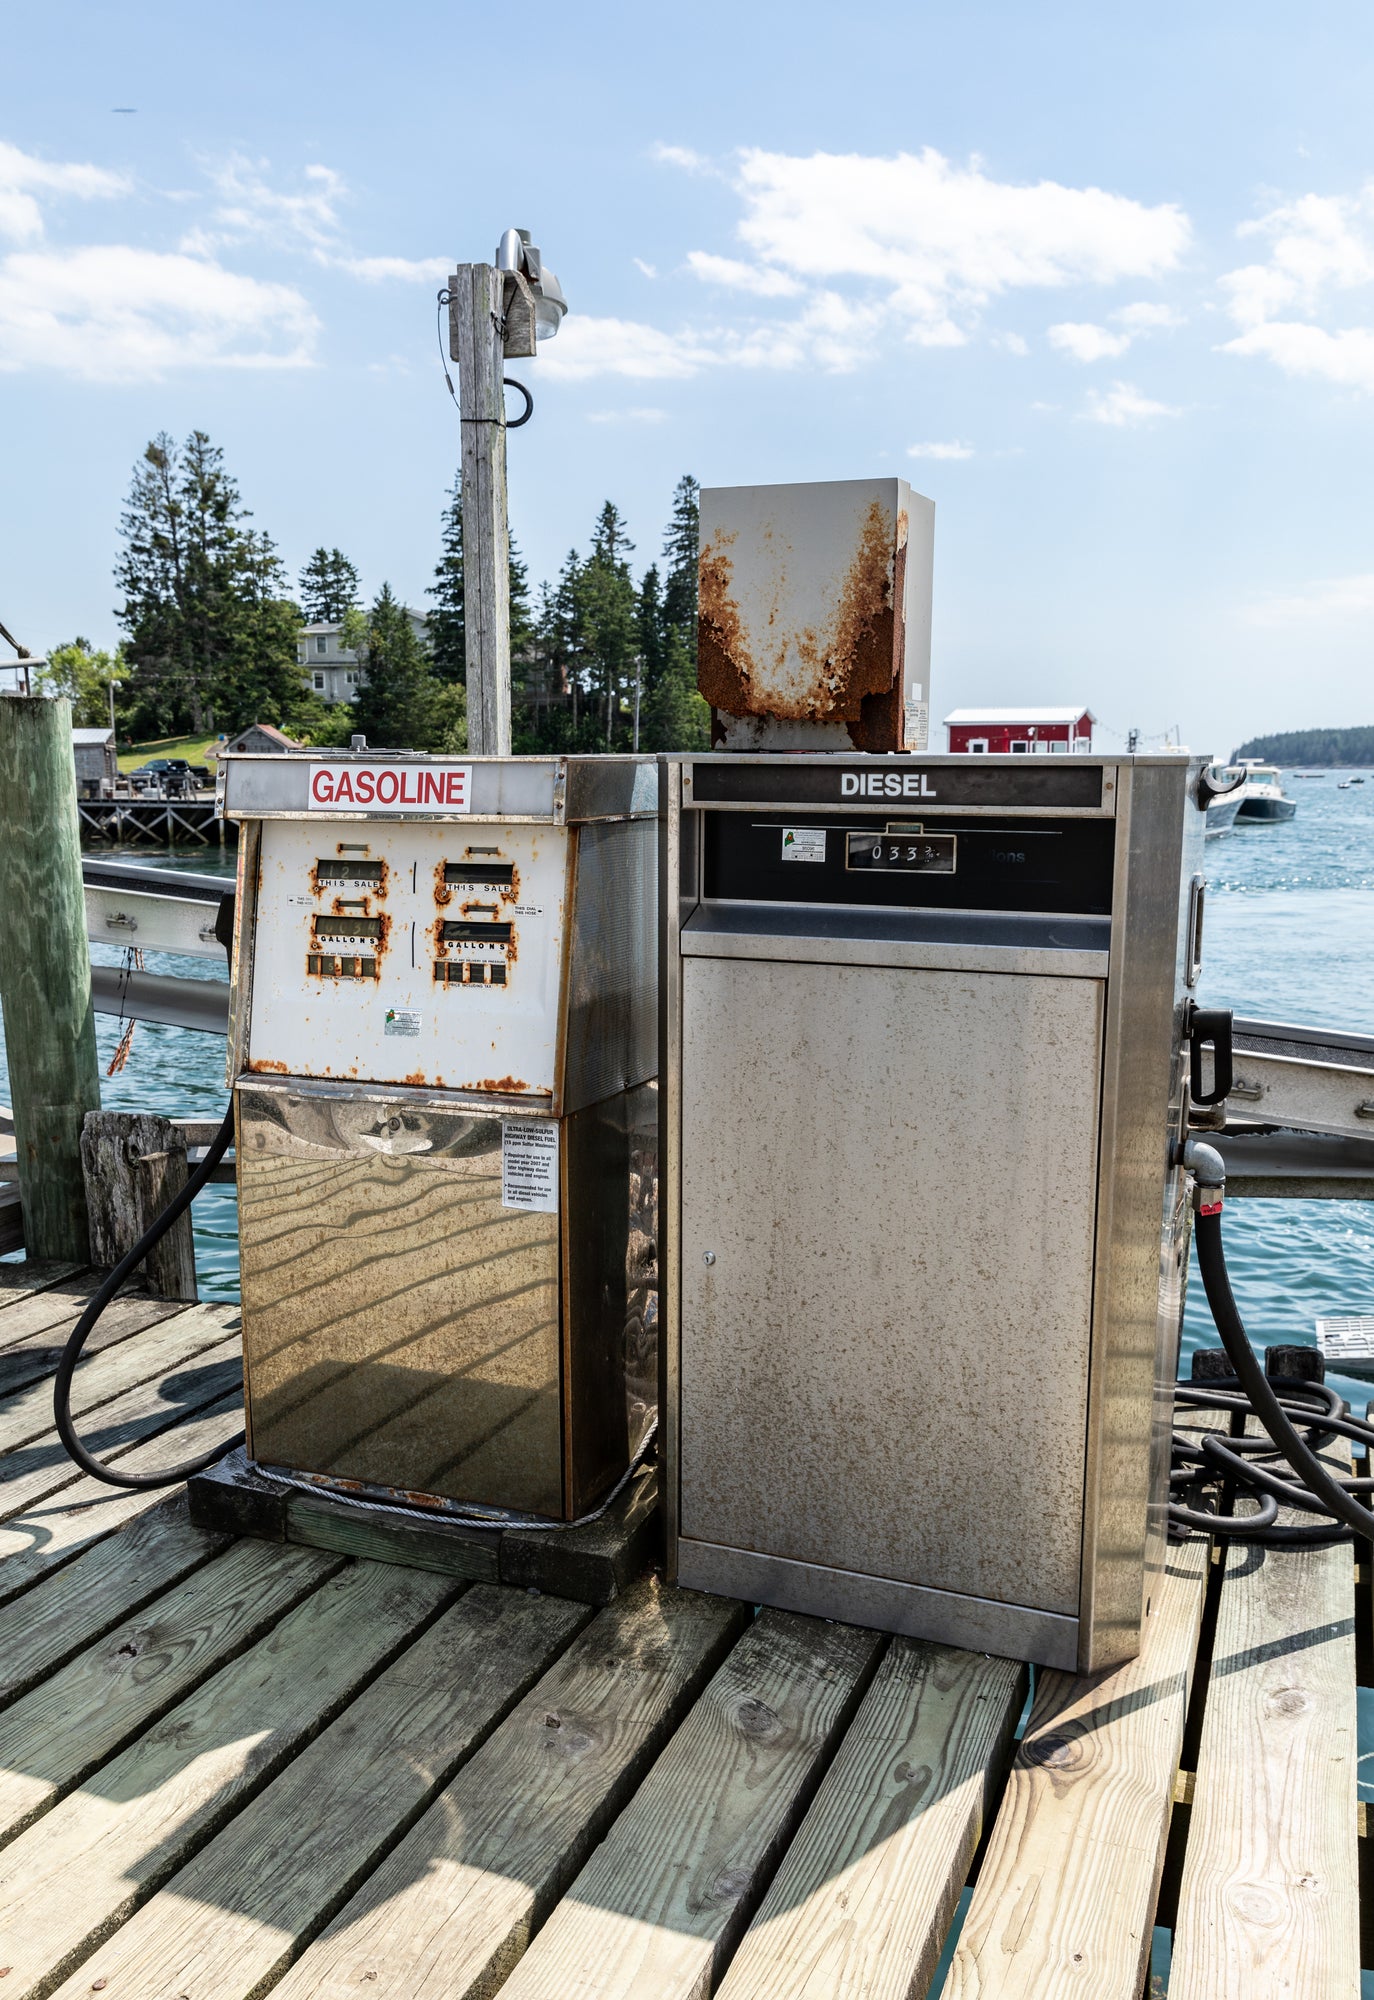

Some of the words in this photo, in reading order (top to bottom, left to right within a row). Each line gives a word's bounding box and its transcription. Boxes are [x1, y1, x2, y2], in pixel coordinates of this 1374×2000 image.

[312, 769, 466, 805] GASOLINE
[841, 773, 937, 797] DIESEL
[320, 879, 346, 887] THIS
[447, 884, 475, 892] THIS
[484, 885, 510, 893] SALE
[320, 935, 376, 945] GALLONS
[448, 941, 506, 950] GALLONS
[507, 1126, 554, 1135] ULTRA-LOW-SULFUR
[518, 1165, 534, 1173] highway
